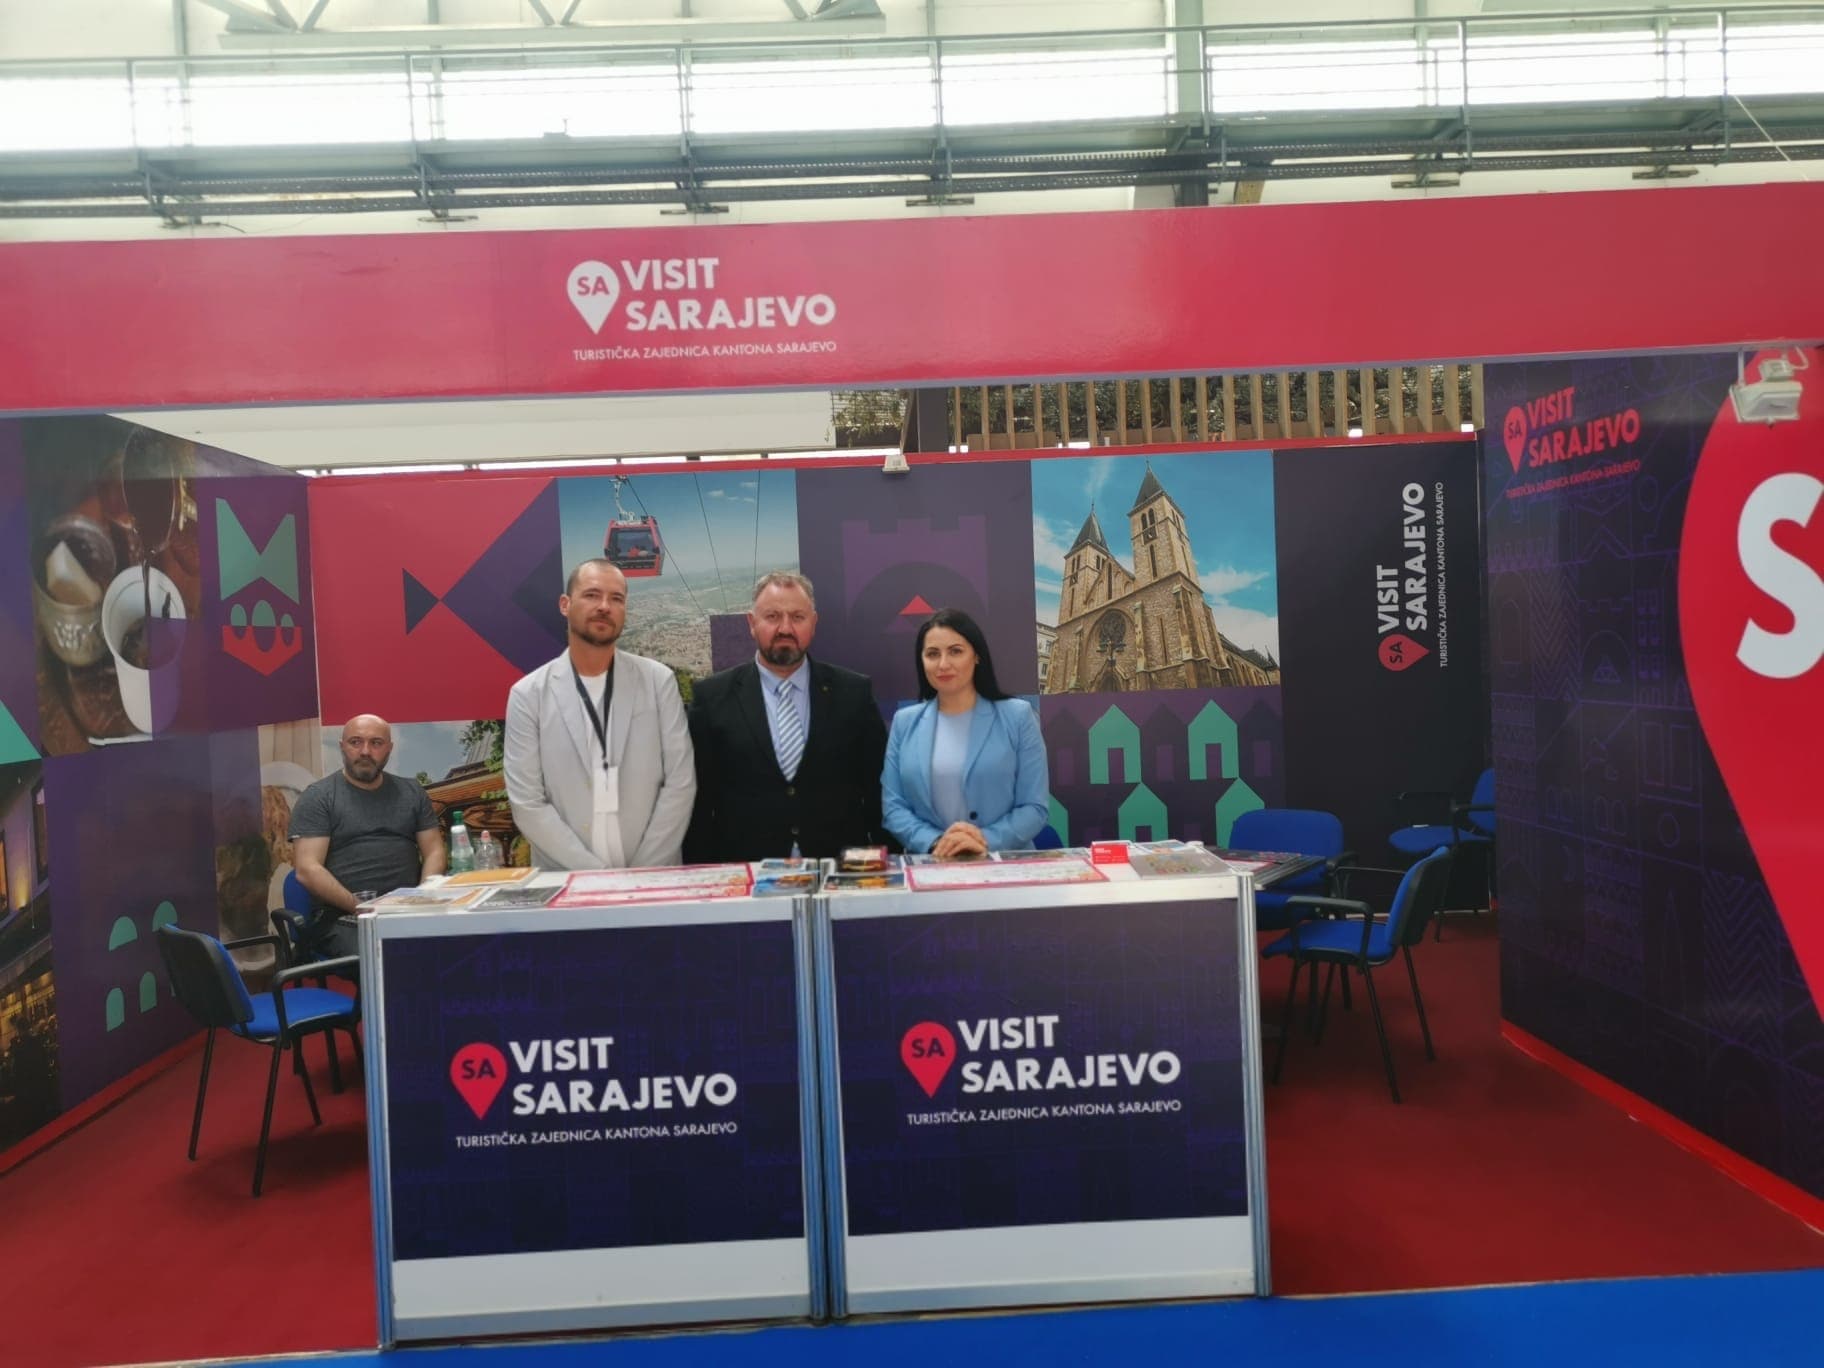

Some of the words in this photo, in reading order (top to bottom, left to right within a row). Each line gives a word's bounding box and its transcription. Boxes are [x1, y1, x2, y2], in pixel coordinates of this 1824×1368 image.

[577, 276, 610, 296] SA
[621, 257, 719, 291] VISIT
[626, 293, 836, 331] SARAJEVO
[573, 345, 641, 361] TURISTIČKA
[643, 345, 710, 359] ZAJEDNICA
[712, 343, 774, 356] KANTONA
[776, 340, 837, 354] SARAJEVO
[1527, 386, 1575, 429] VISIT
[1508, 421, 1523, 440] SA
[1529, 408, 1641, 468] SARAJEVO
[1434, 481, 1444, 526] SARAJEVO
[1402, 482, 1427, 631] SARAJEVO
[1436, 526, 1446, 570] KANTONA
[1376, 564, 1399, 634] VISIT
[1437, 572, 1447, 619] ZAJEDNICA
[1389, 641, 1403, 663] SA
[1437, 621, 1448, 667] TURISTIČKA
[911, 1036, 945, 1058] SA
[958, 1015, 1059, 1052] VISIT
[461, 1058, 496, 1080] SA
[508, 1036, 614, 1073] VISIT
[961, 1050, 1181, 1093] SARAJEVO
[512, 1072, 737, 1116] SARAJEVO
[907, 1108, 977, 1126] TURISTIČKA
[979, 1106, 1049, 1121] ZAJEDNICA
[1051, 1102, 1115, 1117] KANTONA
[1117, 1099, 1182, 1114] SARAJEVO
[455, 1131, 528, 1148] TURISTIČKA
[530, 1129, 602, 1144] ZAJEDNICA
[604, 1125, 670, 1140] KANTONA
[672, 1121, 738, 1136] SARAJEVO
